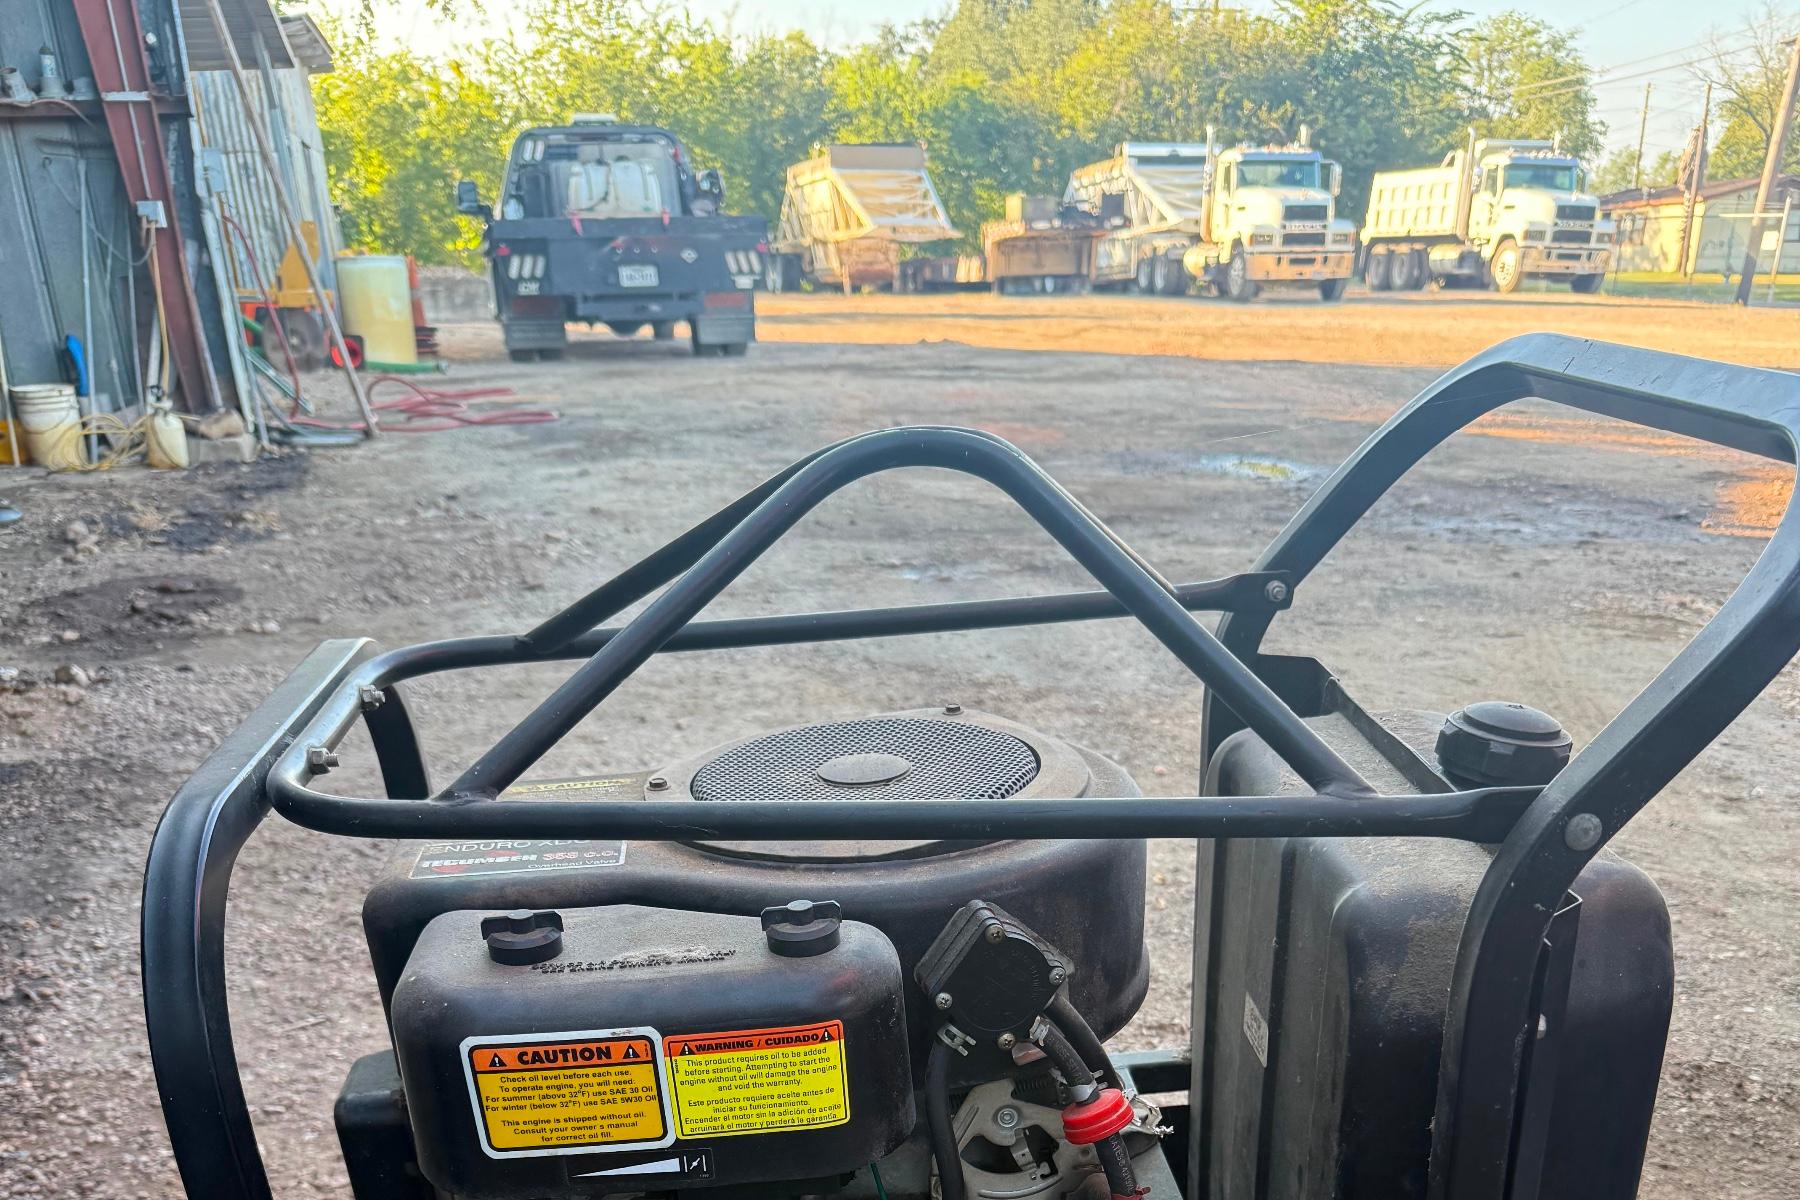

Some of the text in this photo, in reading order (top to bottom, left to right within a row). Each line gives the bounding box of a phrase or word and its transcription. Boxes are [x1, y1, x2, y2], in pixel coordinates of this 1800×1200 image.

[422, 854, 538, 868] TECUMSEH
[695, 1040, 754, 1052] WARNING
[765, 1033, 820, 1046] CUIDADO
[517, 1046, 613, 1066] CAUTION
[686, 1059, 703, 1067] This
[704, 1056, 735, 1067] product
[736, 1054, 769, 1063] requires
[770, 1052, 780, 1060] oil
[803, 1047, 827, 1056] added
[684, 1068, 710, 1077] before
[712, 1065, 744, 1074] starting.
[745, 1060, 788, 1071] Attempting
[799, 1058, 818, 1067] start
[818, 1056, 831, 1064] the
[528, 1074, 540, 1082] oil
[541, 1073, 561, 1081] level
[563, 1071, 590, 1080] before
[592, 1070, 612, 1078] each
[614, 1069, 632, 1077] use.
[679, 1064, 838, 1087] engine without oil will damage the engine
[499, 1085, 510, 1093] To
[512, 1084, 543, 1093] operate
[578, 1082, 594, 1090] you
[596, 1079, 611, 1087] will
[718, 1078, 803, 1092] and void the warranty.
[485, 1095, 499, 1103] For
[502, 1094, 535, 1102] summer
[538, 1092, 566, 1101] (above
[609, 1087, 627, 1096] SAE
[629, 1086, 639, 1094] 30
[641, 1085, 653, 1093] Oil
[687, 1086, 835, 1107] Este producto requiere aceite antes de
[529, 1102, 557, 1111] (below
[600, 1097, 618, 1106] SAE
[620, 1095, 643, 1104] 5W30
[644, 1094, 657, 1102] Oil
[713, 1106, 737, 1114] iniciar
[522, 1118, 551, 1126] engine
[563, 1114, 598, 1123] shipped
[599, 1112, 631, 1121] without
[685, 1116, 721, 1125] Encender
[732, 1112, 754, 1120] motor
[755, 1111, 767, 1119] sin
[818, 1103, 842, 1113] aceite
[513, 1127, 547, 1135] Consult
[549, 1126, 568, 1135] your
[607, 1121, 638, 1129] manual
[726, 1122, 734, 1130] el
[735, 1120, 757, 1129] motor
[555, 1133, 586, 1142] correct
